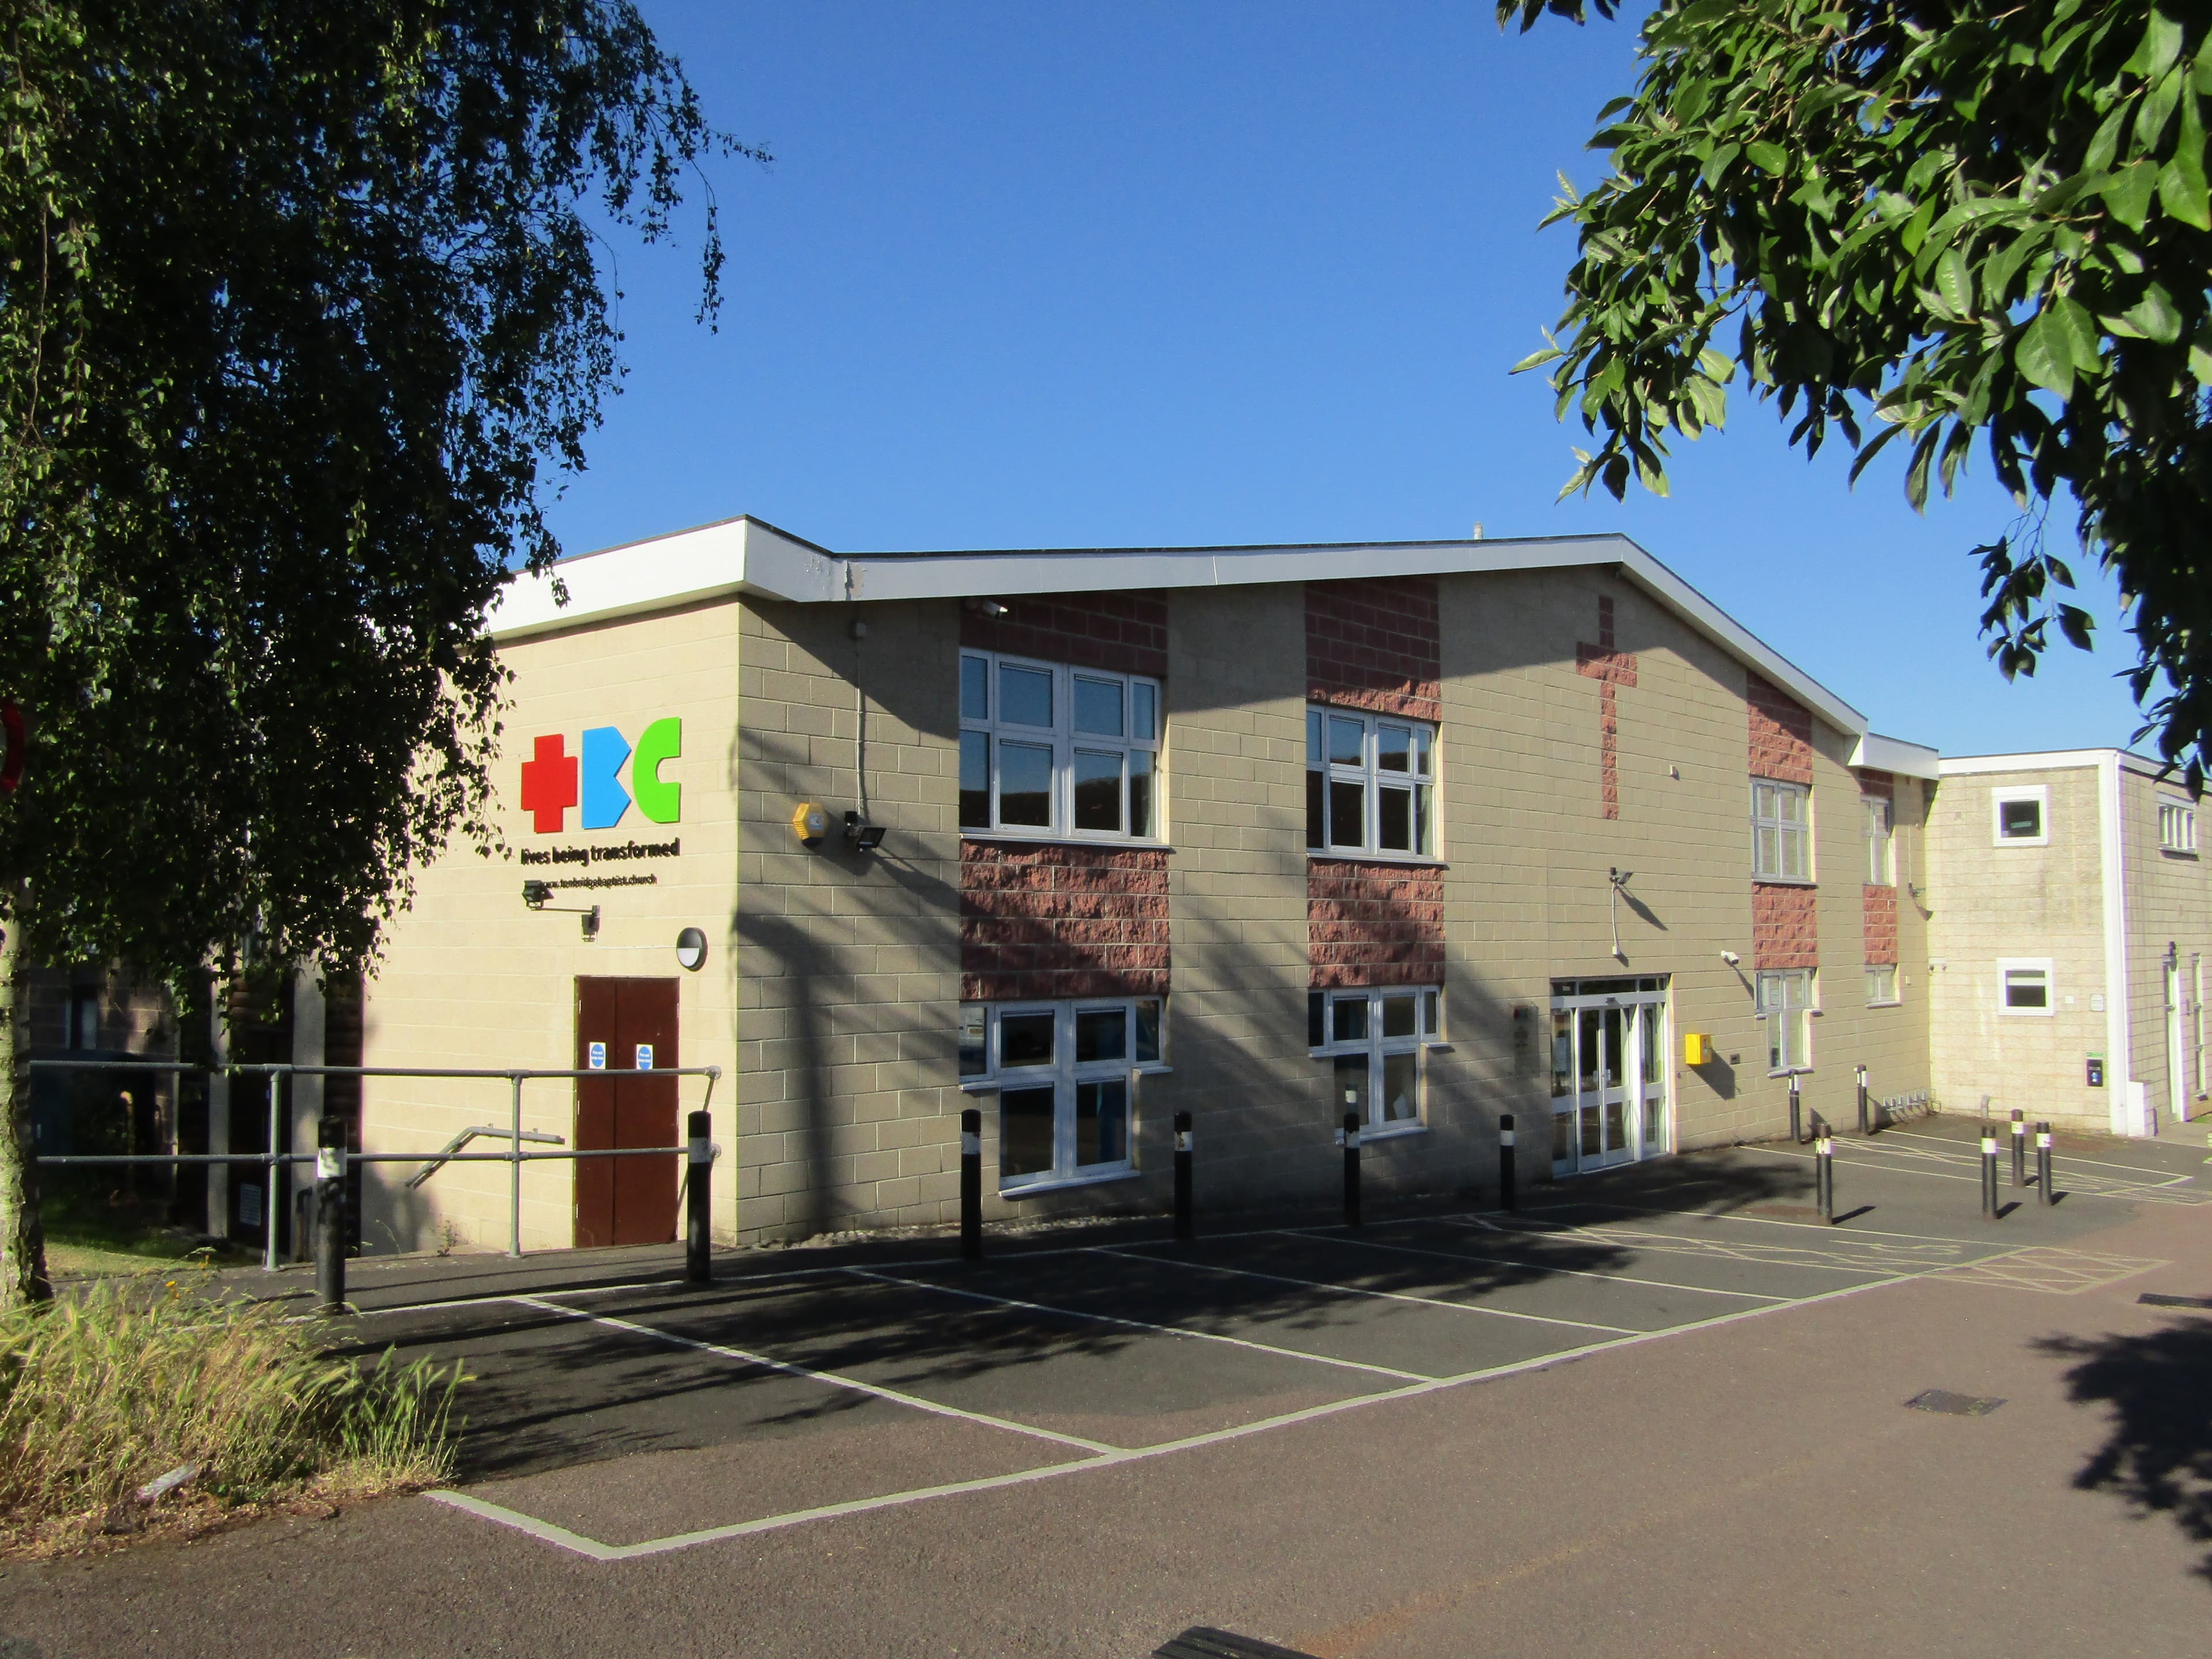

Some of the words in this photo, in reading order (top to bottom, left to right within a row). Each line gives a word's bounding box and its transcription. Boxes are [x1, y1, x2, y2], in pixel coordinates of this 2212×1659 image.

[521, 848, 551, 865] lives
[552, 846, 589, 867] being
[590, 837, 680, 862] transformed
